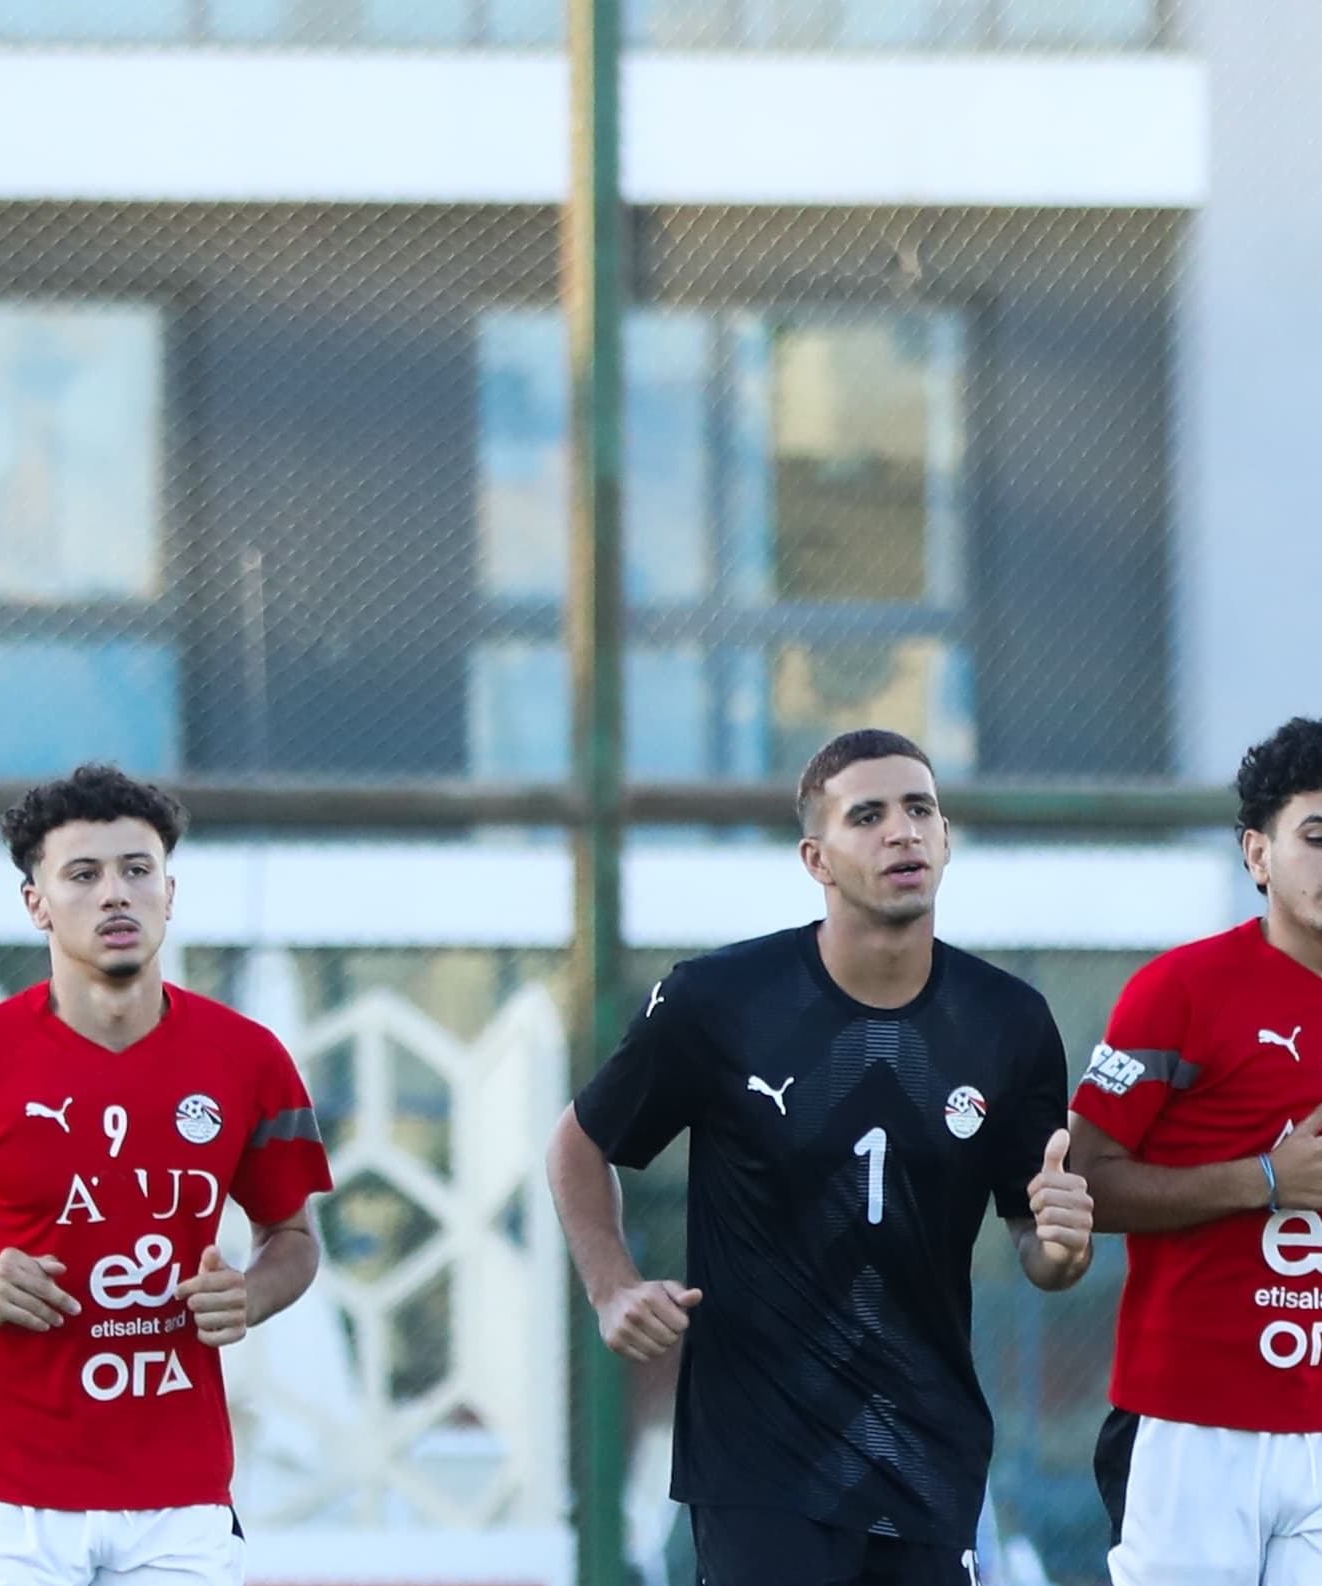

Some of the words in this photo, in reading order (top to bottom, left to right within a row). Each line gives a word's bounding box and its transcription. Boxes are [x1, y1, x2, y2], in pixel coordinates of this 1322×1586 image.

[102, 1104, 128, 1158] 9
[55, 1168, 220, 1225] AUD
[853, 1126, 888, 1225] 1
[90, 1317, 161, 1339] etisalat
